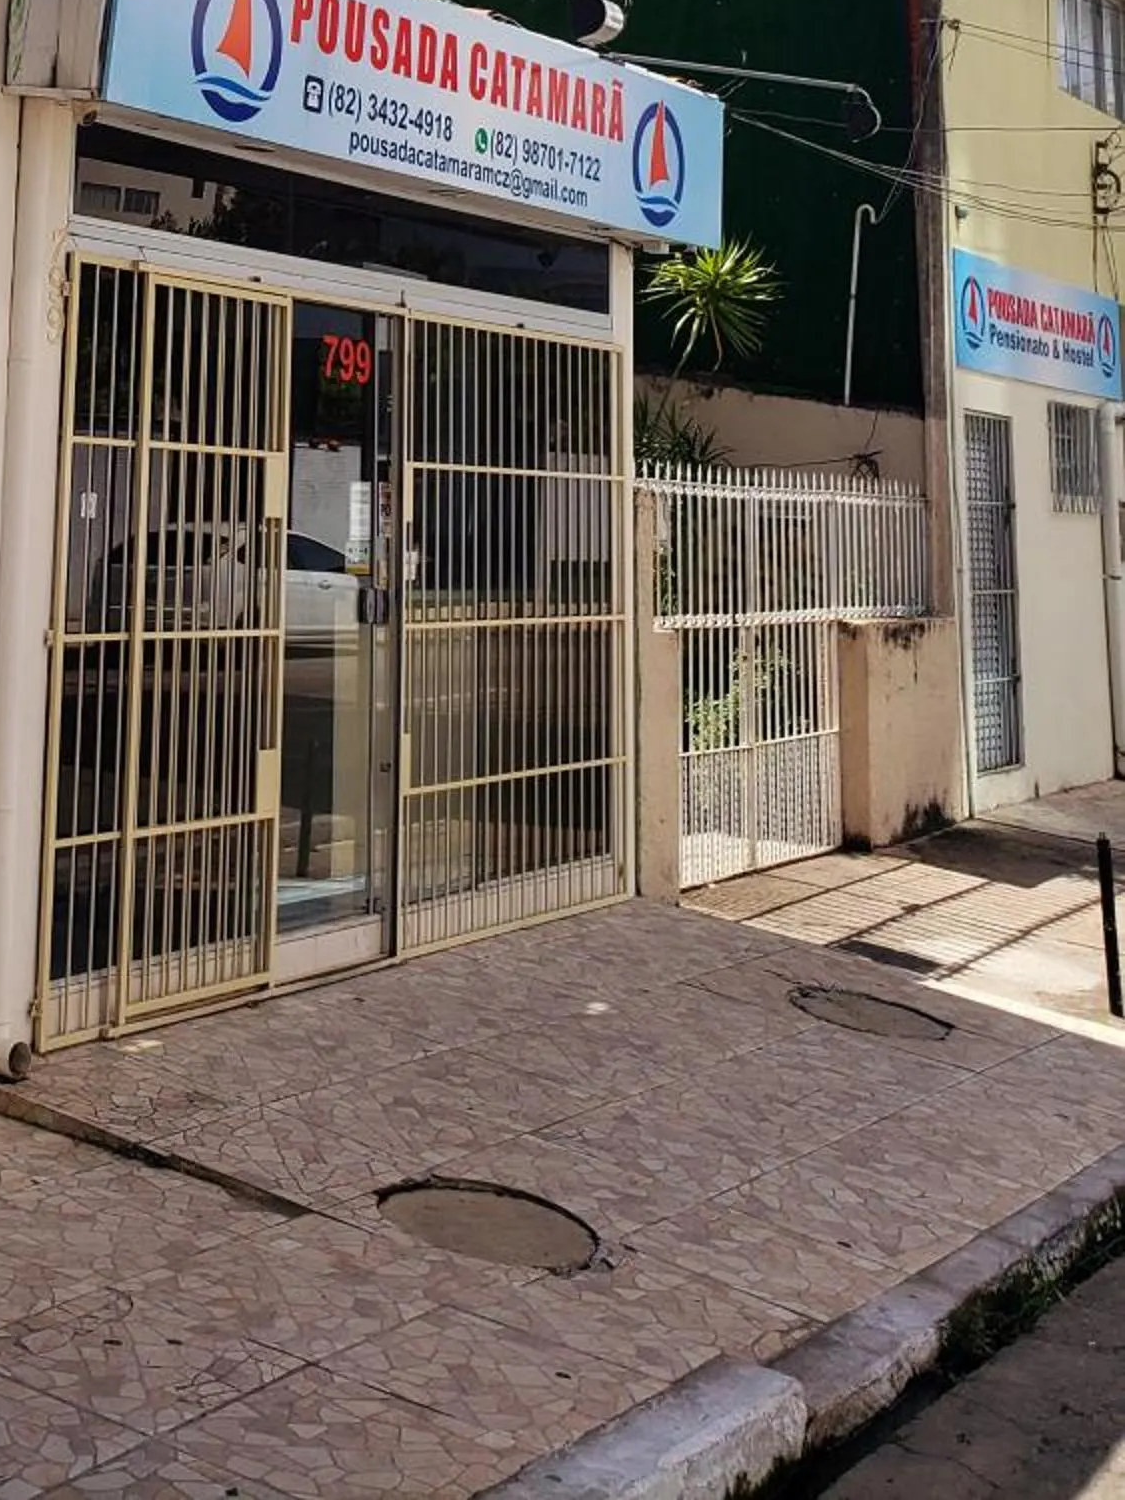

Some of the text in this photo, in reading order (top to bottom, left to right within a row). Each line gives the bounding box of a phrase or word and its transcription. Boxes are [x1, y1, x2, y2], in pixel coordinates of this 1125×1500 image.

[469, 42, 624, 142] CATAMARÃ
[328, 81, 602, 182] (82) 3432-4918 (82) 98701-7122
[348, 130, 588, 208] pousadacatamaramcz@gmail.com
[987, 288, 1096, 345] POUSADA CATAMARÃ
[989, 324, 1050, 358] Pensionato
[1062, 341, 1094, 368] Hostel
[322, 333, 372, 385] 799
